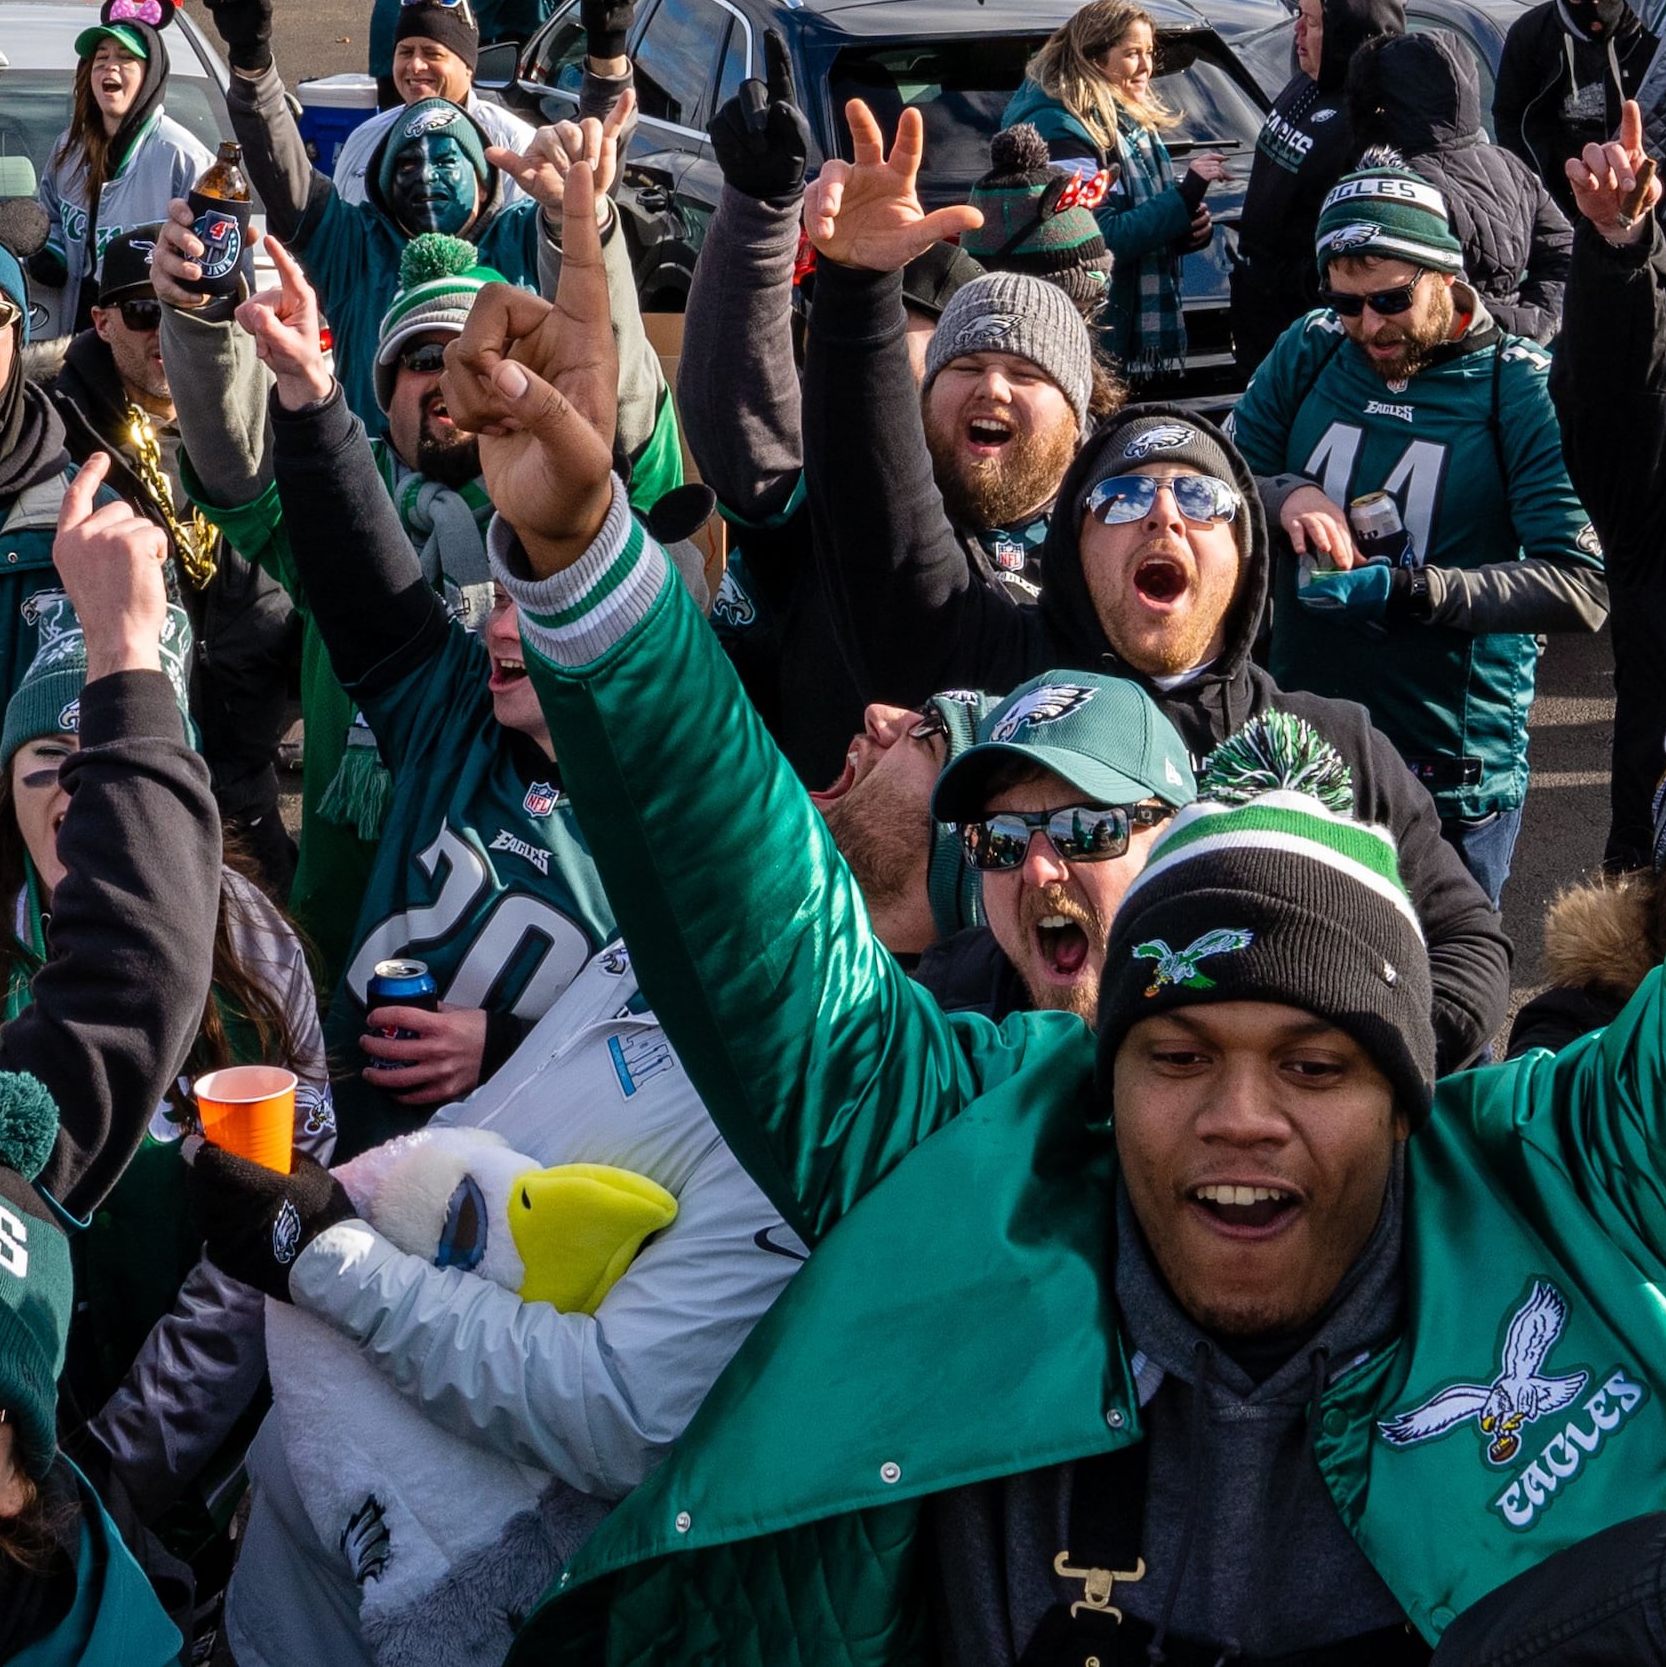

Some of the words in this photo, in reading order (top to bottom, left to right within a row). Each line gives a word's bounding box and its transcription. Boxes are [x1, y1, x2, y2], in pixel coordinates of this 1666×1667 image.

[1362, 399, 1415, 423] EAGLES
[999, 554, 1021, 573] NFL
[527, 793, 552, 812] NFL
[489, 828, 554, 875] EAGLES
[1495, 1369, 1644, 1526] EAGLES
